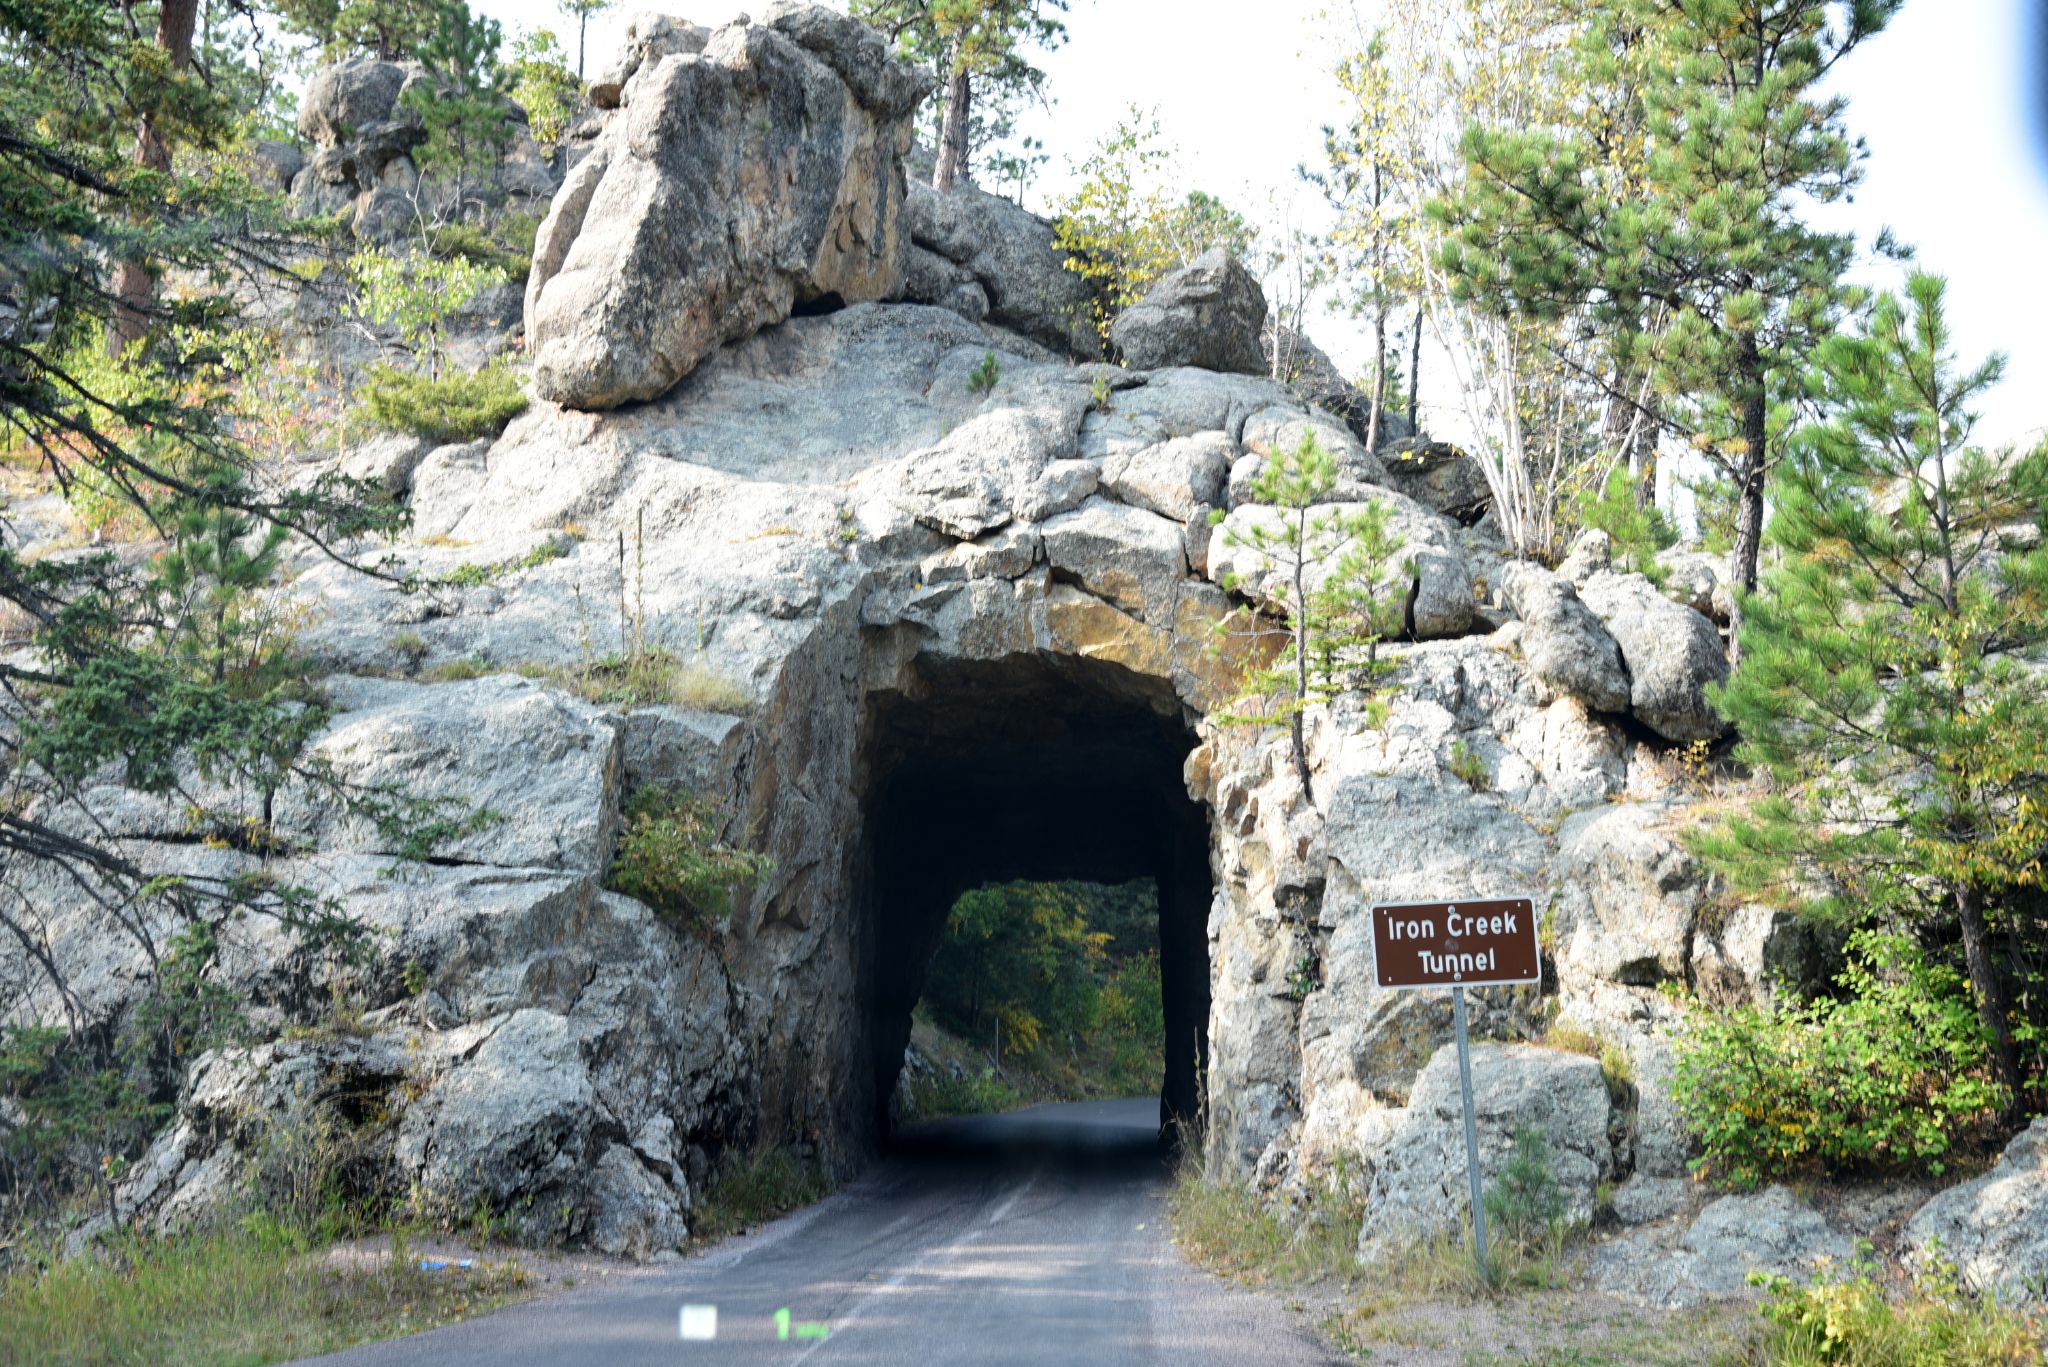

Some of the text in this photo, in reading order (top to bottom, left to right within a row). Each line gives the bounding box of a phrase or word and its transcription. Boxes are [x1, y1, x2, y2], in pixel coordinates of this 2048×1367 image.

[1388, 911, 1517, 940] Iron Creek
[1418, 947, 1495, 974] Tunnel
